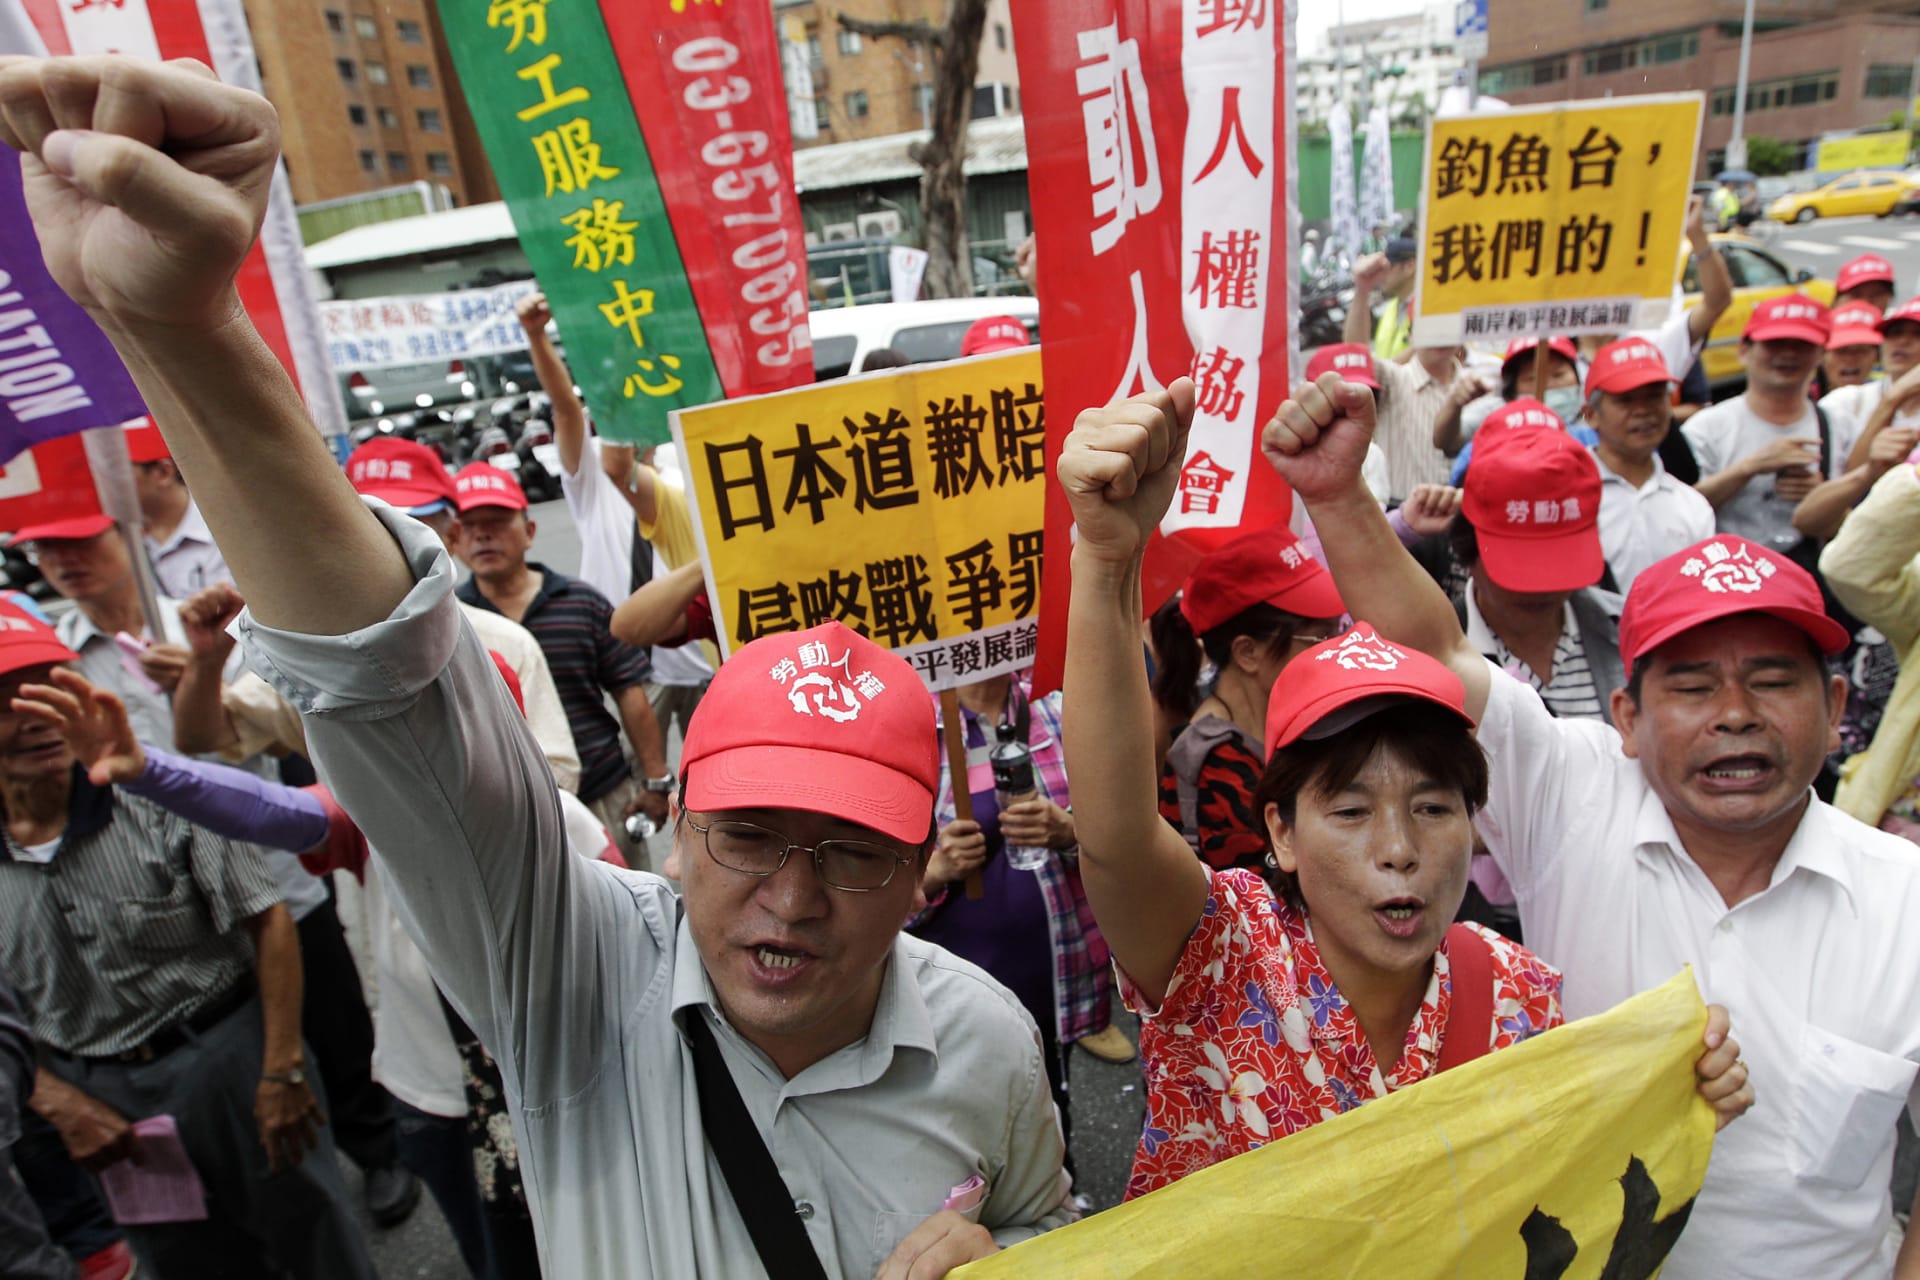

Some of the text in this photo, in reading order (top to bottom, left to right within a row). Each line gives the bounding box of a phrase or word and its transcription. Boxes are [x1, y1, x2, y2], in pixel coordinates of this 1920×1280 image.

[487, 0, 683, 398] 勞工服務中心
[671, 36, 812, 368] 03-6570655
[768, 640, 887, 700] 勞動人權
[903, 623, 1038, 682] 平發展論
